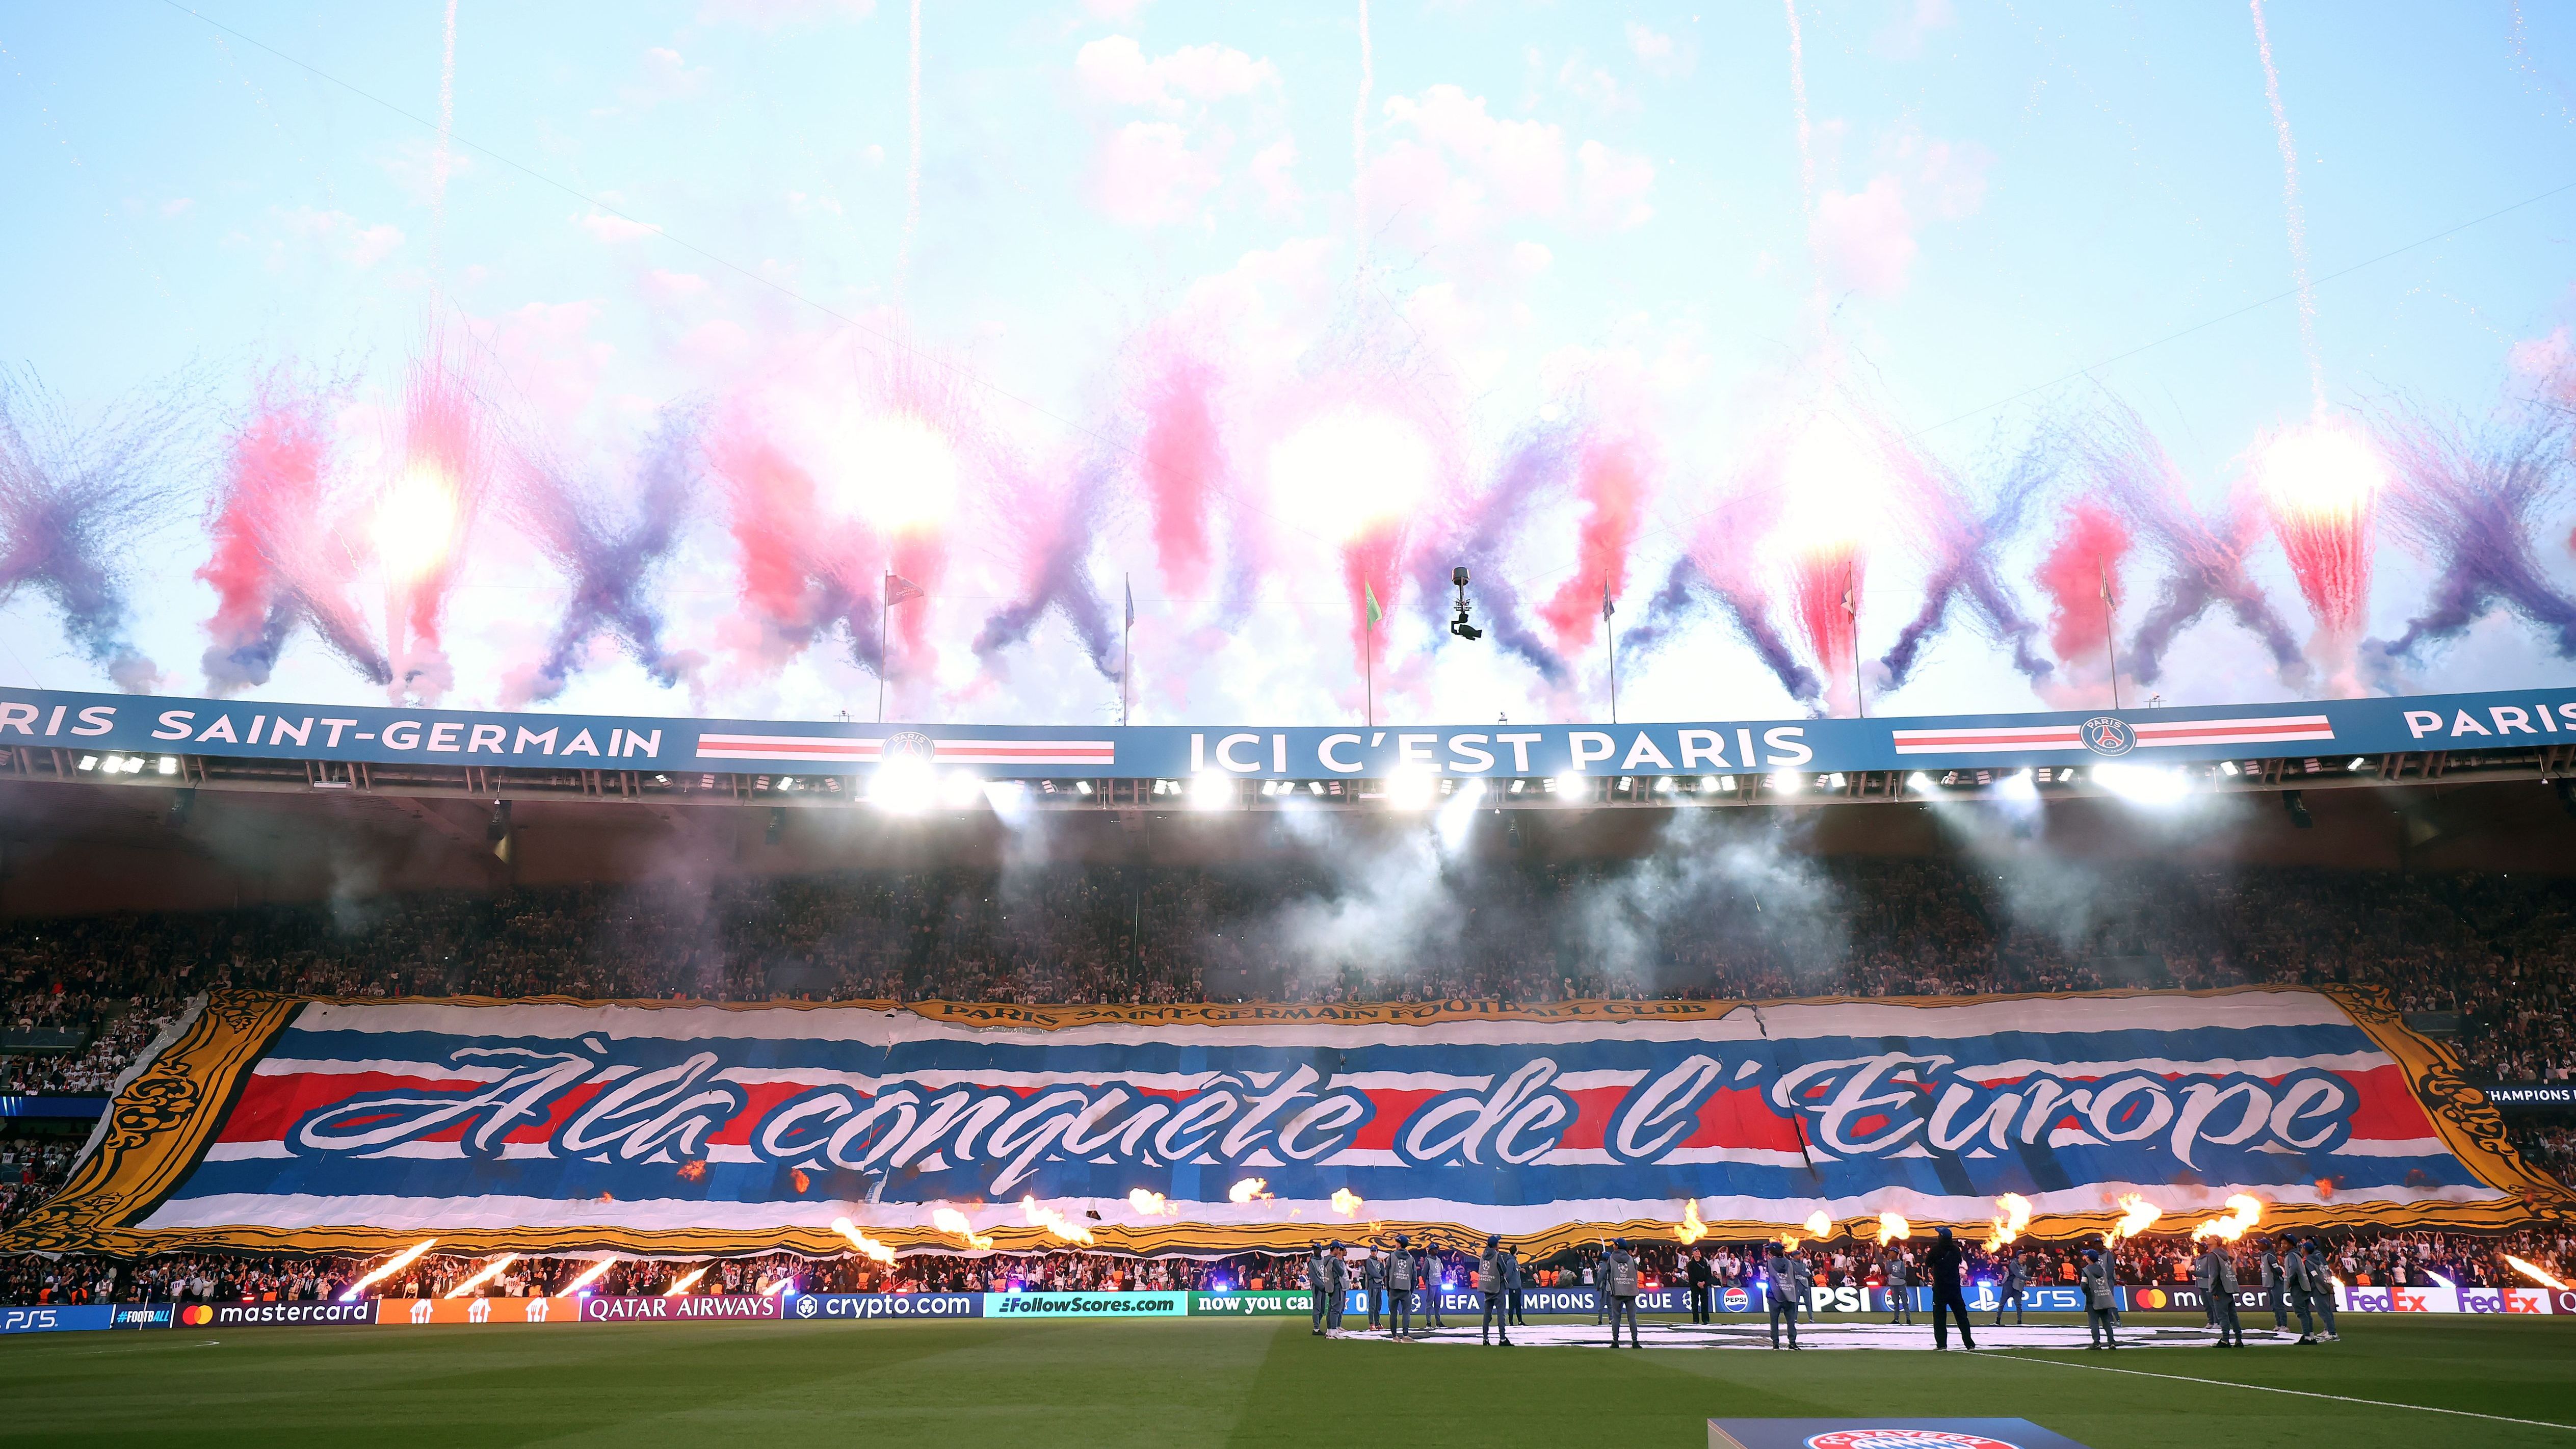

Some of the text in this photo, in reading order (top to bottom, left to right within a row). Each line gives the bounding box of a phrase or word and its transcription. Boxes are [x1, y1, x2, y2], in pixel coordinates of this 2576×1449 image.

[151, 710, 662, 758] SAINT-GERMAIN
[2087, 719, 2121, 729] PARIS
[892, 733, 926, 743] PARIS
[1191, 727, 1813, 773] ICI C'EST PARIS
[943, 1005, 1060, 1025] PARIS
[1602, 1004, 1706, 1014] CLUB
[2485, 1090, 2570, 1101] HAMPIONS
[562, 1051, 734, 1160] la
[762, 1063, 1366, 1196] conquête
[1405, 1057, 1566, 1165] de
[826, 1295, 970, 1319] crypto.com
[1010, 1297, 1174, 1312] FollowScores.com
[1198, 1297, 1242, 1311] now
[1244, 1297, 1283, 1314] you
[2345, 1286, 2429, 1312] FedEx
[2456, 1287, 2541, 1313] FedEx
[117, 1310, 170, 1323] #FOOTBALL
[220, 1302, 369, 1322] mastercard
[589, 1297, 774, 1322] QATAR AIRWAYS
[1820, 1431, 1992, 1445] FC BAYERN
